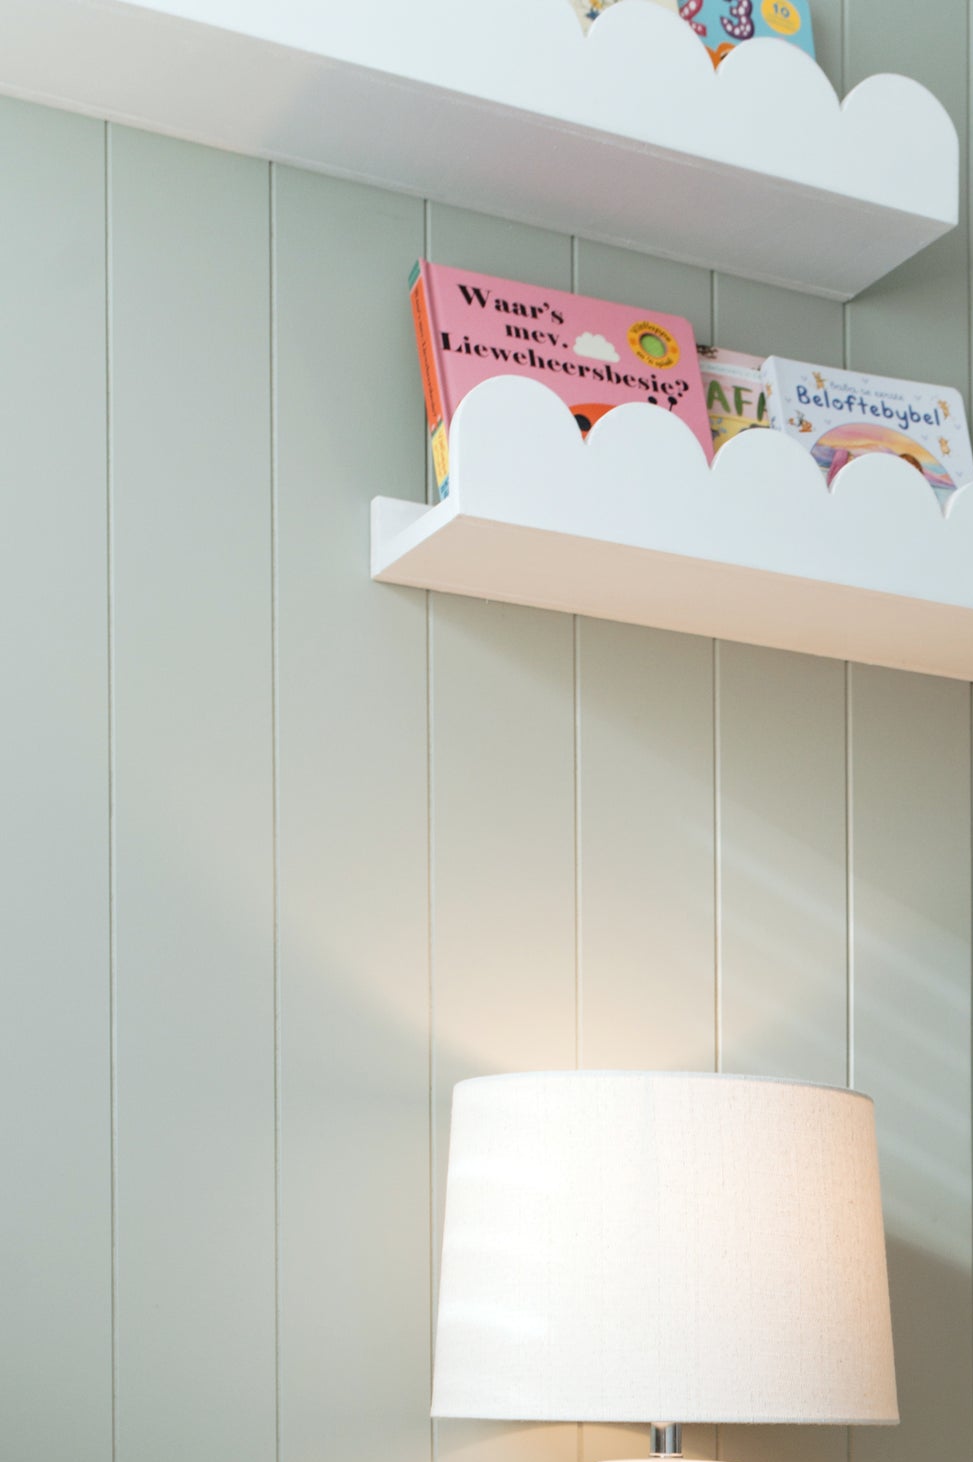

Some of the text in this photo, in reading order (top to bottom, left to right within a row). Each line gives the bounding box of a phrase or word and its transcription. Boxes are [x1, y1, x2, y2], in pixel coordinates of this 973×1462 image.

[720, 0, 755, 39] 3
[773, 3, 791, 18] 10
[457, 284, 565, 325] Waar's
[505, 324, 568, 348] mev.
[440, 331, 689, 398] Lieweheersbesie?
[796, 385, 941, 430] Beloftebybel
